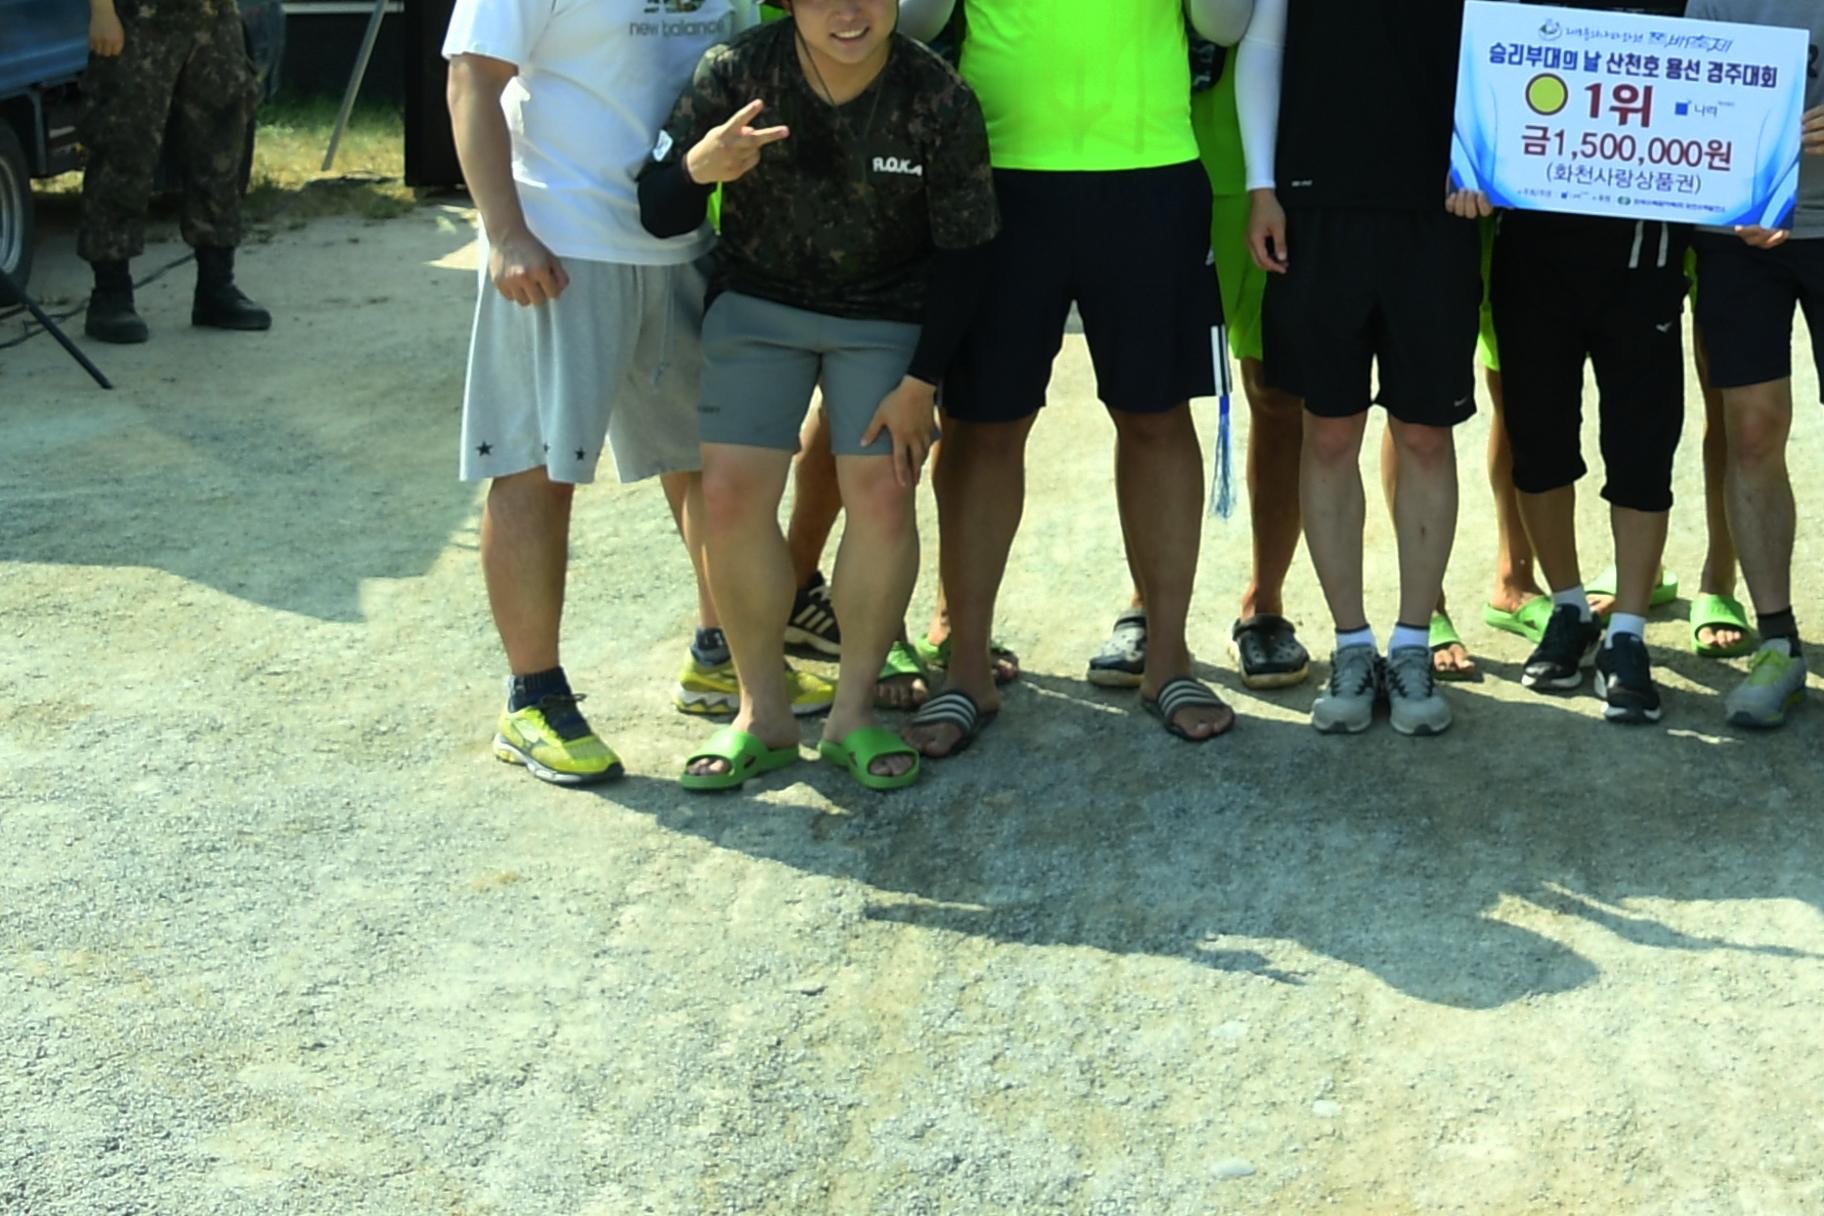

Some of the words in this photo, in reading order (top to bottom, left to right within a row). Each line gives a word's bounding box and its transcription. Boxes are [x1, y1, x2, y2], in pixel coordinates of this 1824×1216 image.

[629, 21, 660, 35] new
[1489, 41, 1577, 71] 승리부대의
[1584, 49, 1602, 73] 날
[1607, 52, 1660, 79] 산천호
[1665, 58, 1701, 81] 용선
[1707, 61, 1778, 88] 경주대회
[1585, 82, 1653, 128] 1위
[1521, 125, 1732, 171] 금1,500,000원
[1546, 162, 1701, 194] (화천사랑상품권)
